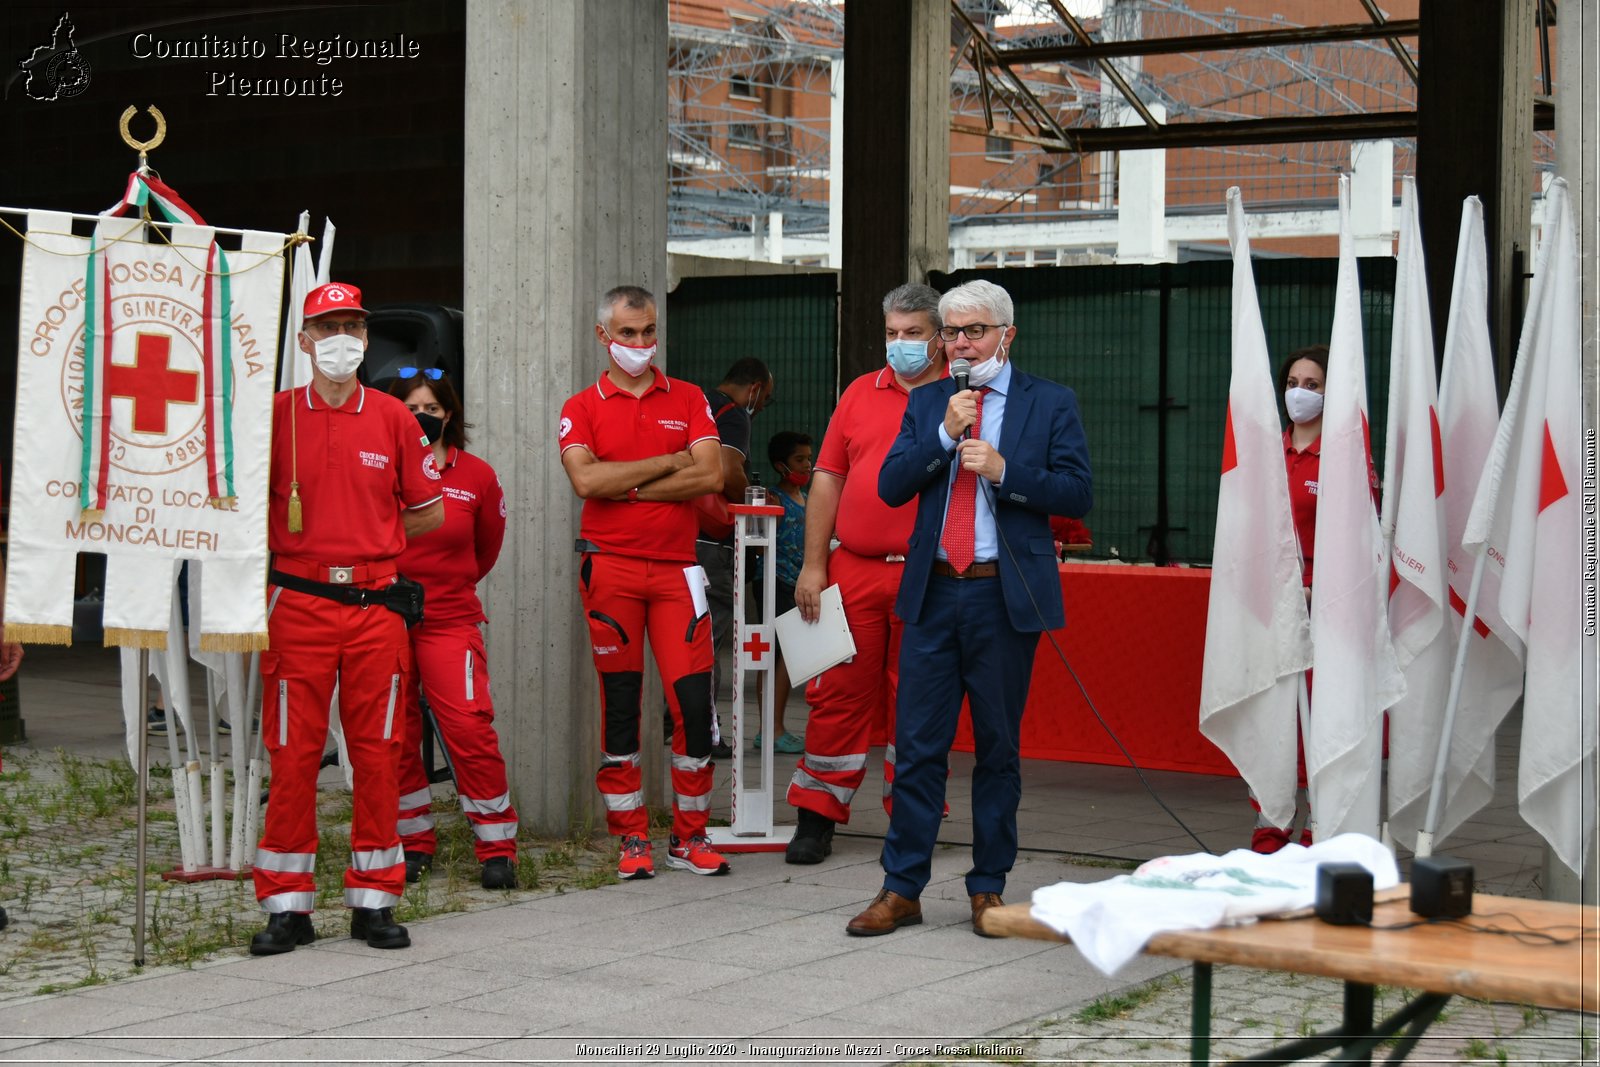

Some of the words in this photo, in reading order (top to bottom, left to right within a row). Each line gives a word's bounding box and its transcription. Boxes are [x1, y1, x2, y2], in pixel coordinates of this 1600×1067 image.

[109, 260, 183, 287] OSSA
[46, 480, 153, 505] COTATO
[135, 506, 156, 524] DI
[65, 519, 219, 552] MONCALIERI
